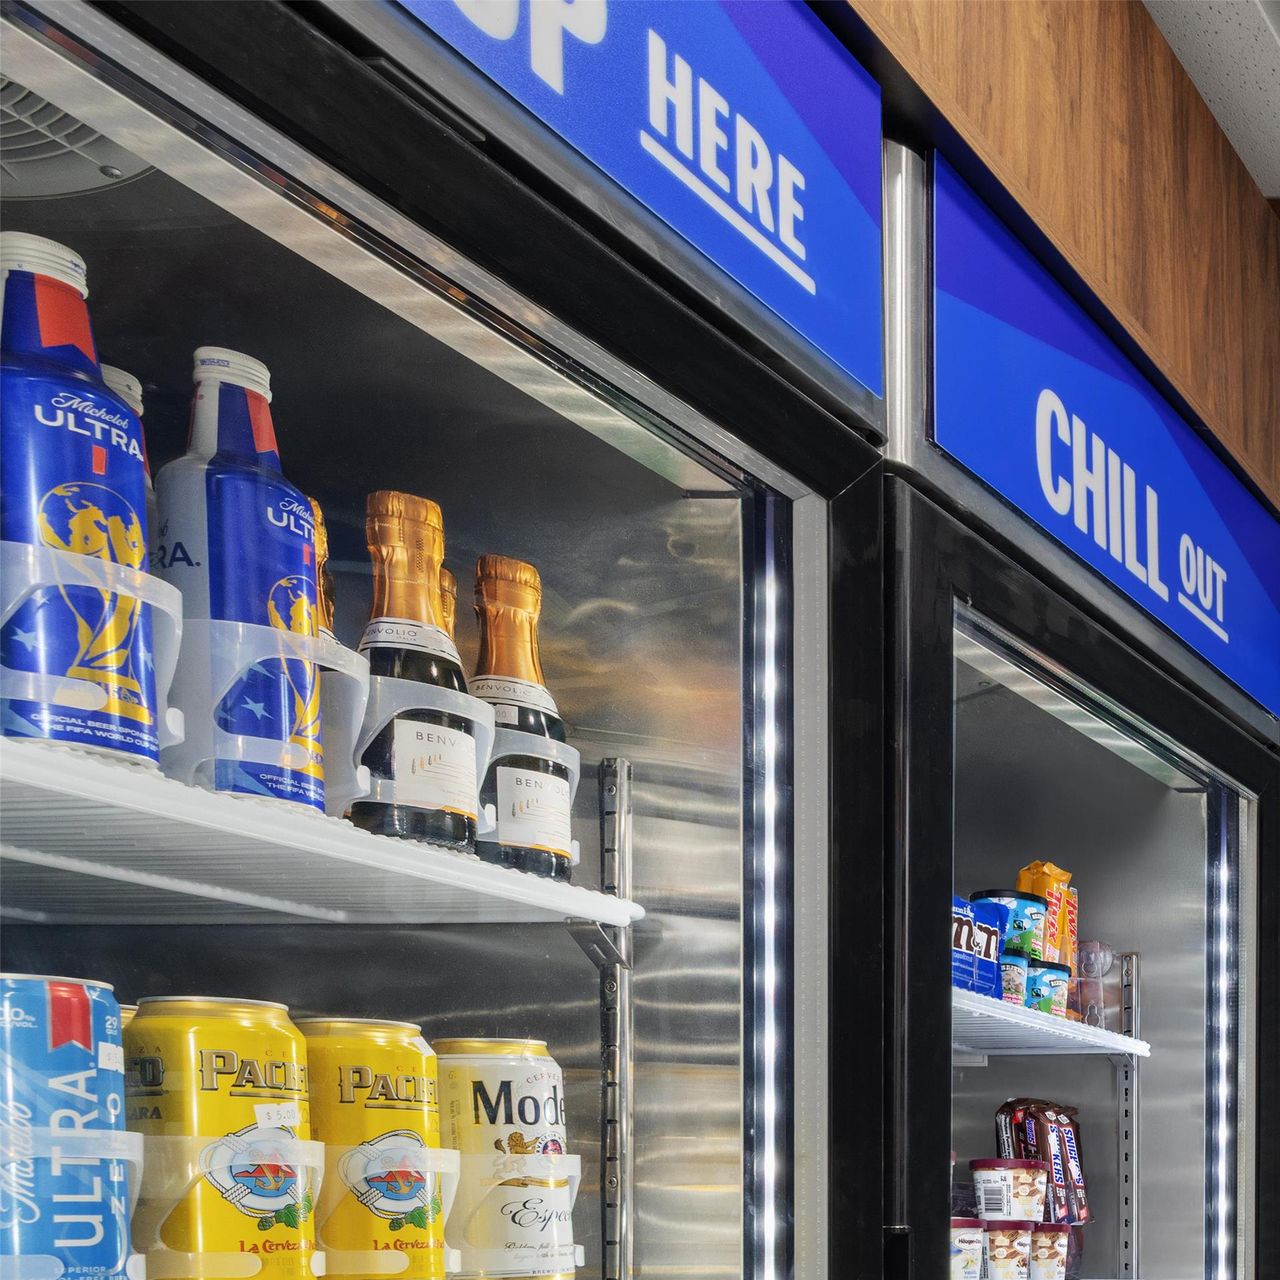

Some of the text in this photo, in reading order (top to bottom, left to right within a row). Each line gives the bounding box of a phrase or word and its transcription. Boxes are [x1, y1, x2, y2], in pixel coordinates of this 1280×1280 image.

[647, 28, 807, 261] HERE
[51, 392, 130, 430] Michelob
[1035, 387, 1229, 623] CHILL OUT
[65, 726, 132, 744] FIFA WORLD
[87, 719, 118, 733] BEER
[239, 1239, 258, 1254] La
[372, 1238, 392, 1252] La
